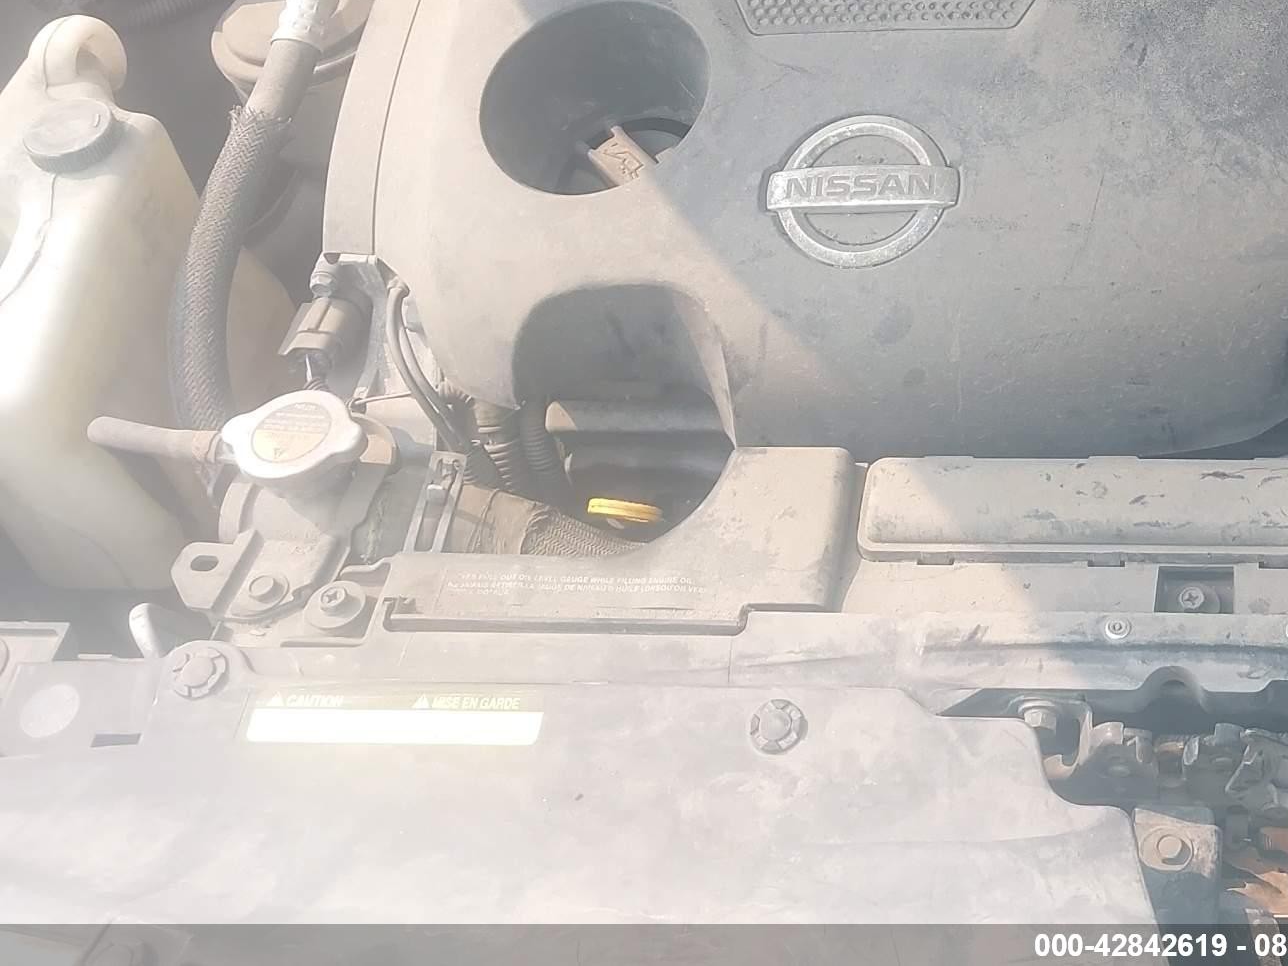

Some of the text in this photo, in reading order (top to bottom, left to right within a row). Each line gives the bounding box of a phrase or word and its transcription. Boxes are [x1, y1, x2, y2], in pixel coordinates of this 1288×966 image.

[785, 173, 934, 199] NISSAN
[285, 694, 345, 708] CAUTION
[431, 696, 520, 710] MISE EN GARDE
